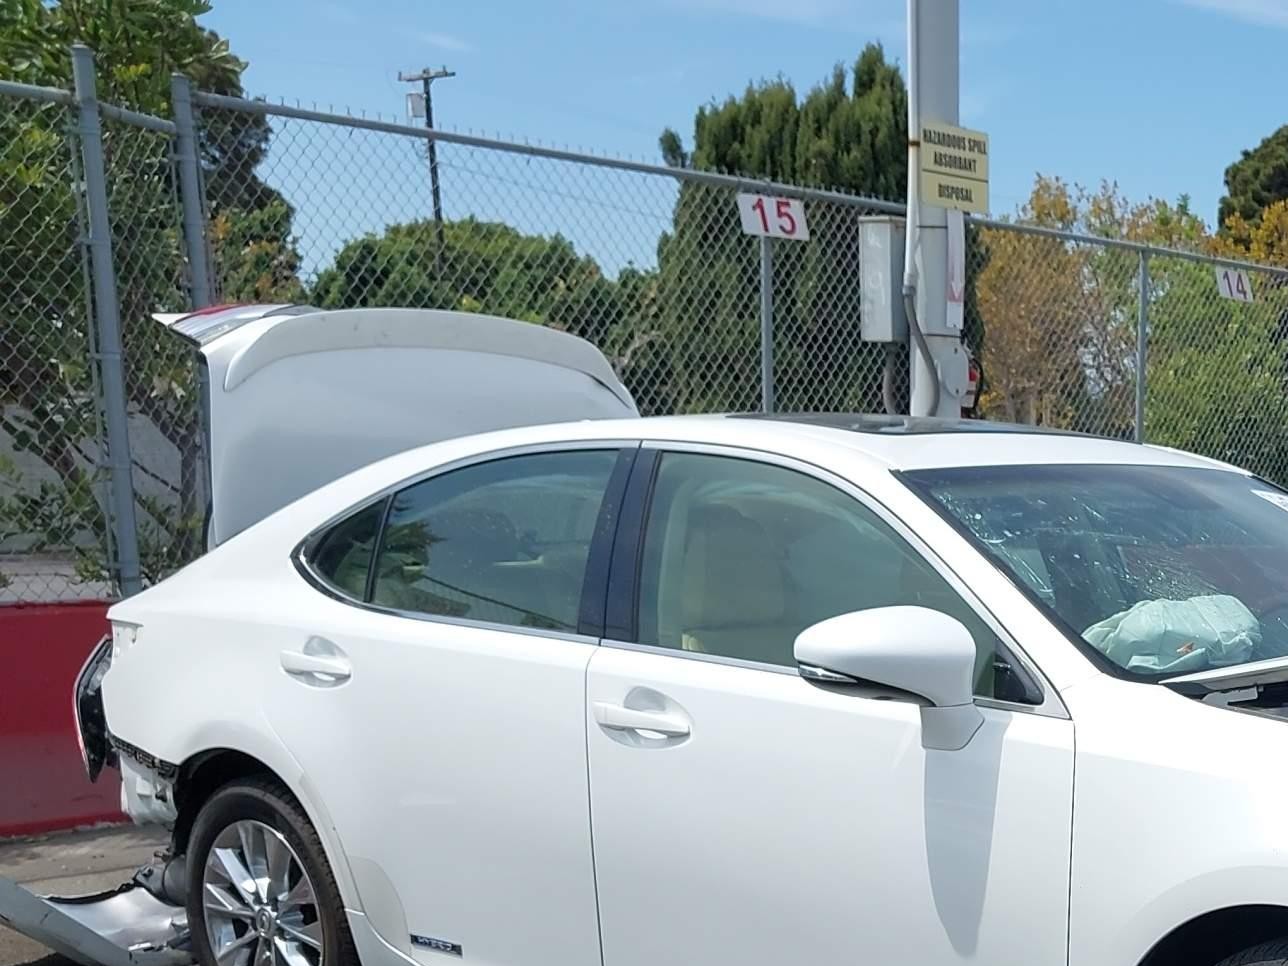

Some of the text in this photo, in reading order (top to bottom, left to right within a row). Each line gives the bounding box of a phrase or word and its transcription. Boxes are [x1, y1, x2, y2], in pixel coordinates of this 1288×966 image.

[922, 127, 987, 155] HAZARDOUS SPILL
[938, 182, 974, 203] DISPOSAL
[751, 198, 797, 235] 15
[1222, 270, 1248, 300] 14
